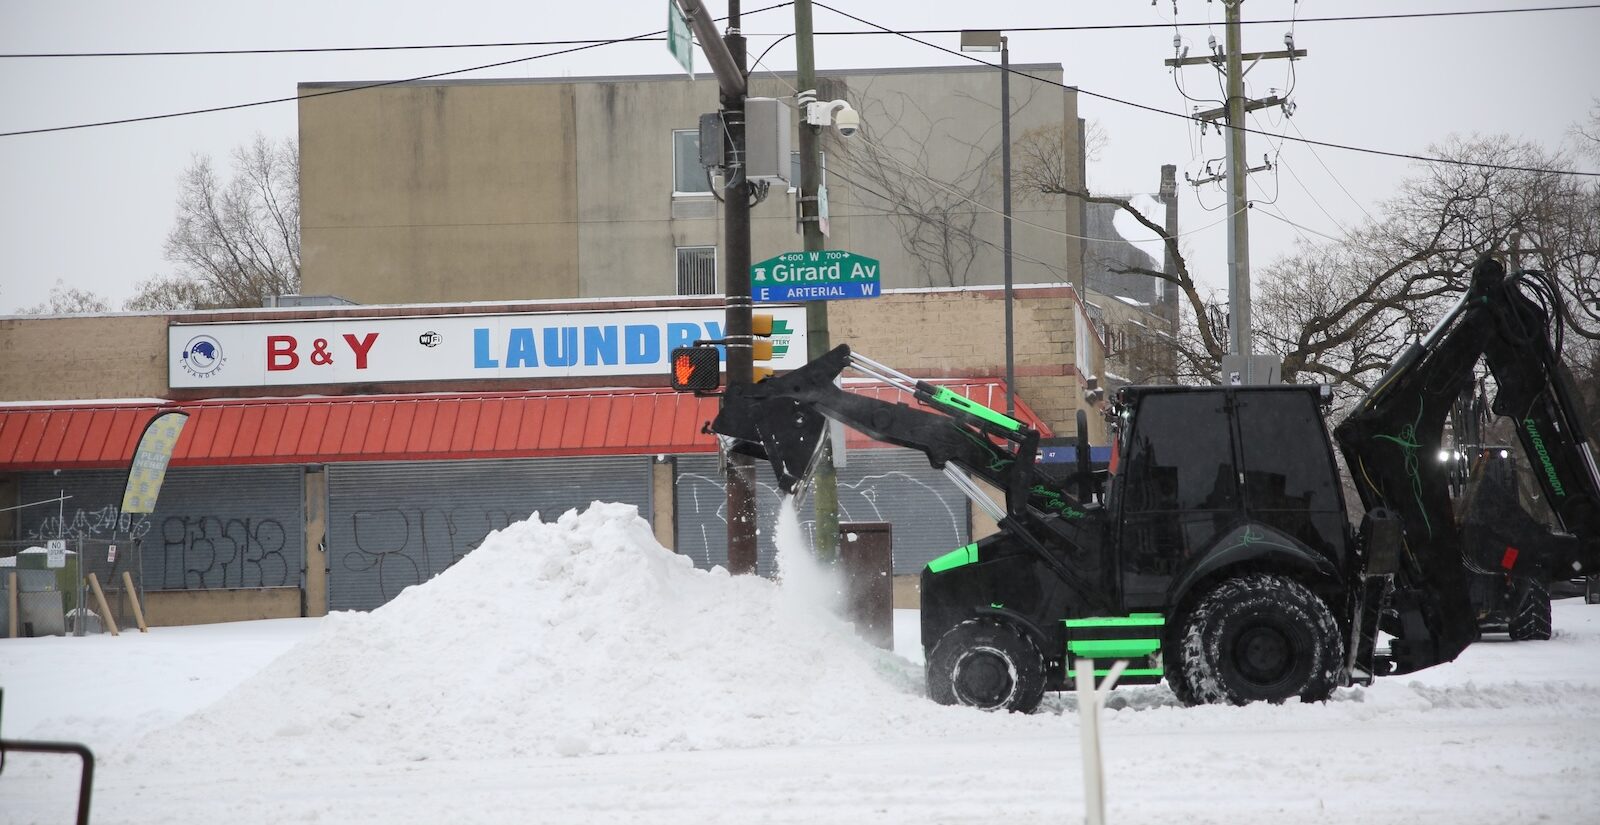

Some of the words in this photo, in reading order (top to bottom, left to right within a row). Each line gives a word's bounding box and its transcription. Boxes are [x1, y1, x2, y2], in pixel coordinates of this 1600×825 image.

[809, 252, 819, 261] W
[826, 252, 841, 260] 700
[772, 262, 840, 282] Girard
[850, 262, 876, 279] Av
[761, 288, 769, 300] E
[787, 286, 845, 298] ARTERIAL
[861, 283, 873, 295] W
[267, 335, 300, 371] B
[310, 338, 334, 366] &
[342, 332, 379, 370] Y
[141, 451, 165, 461] PLAY
[51, 541, 62, 549] NO
